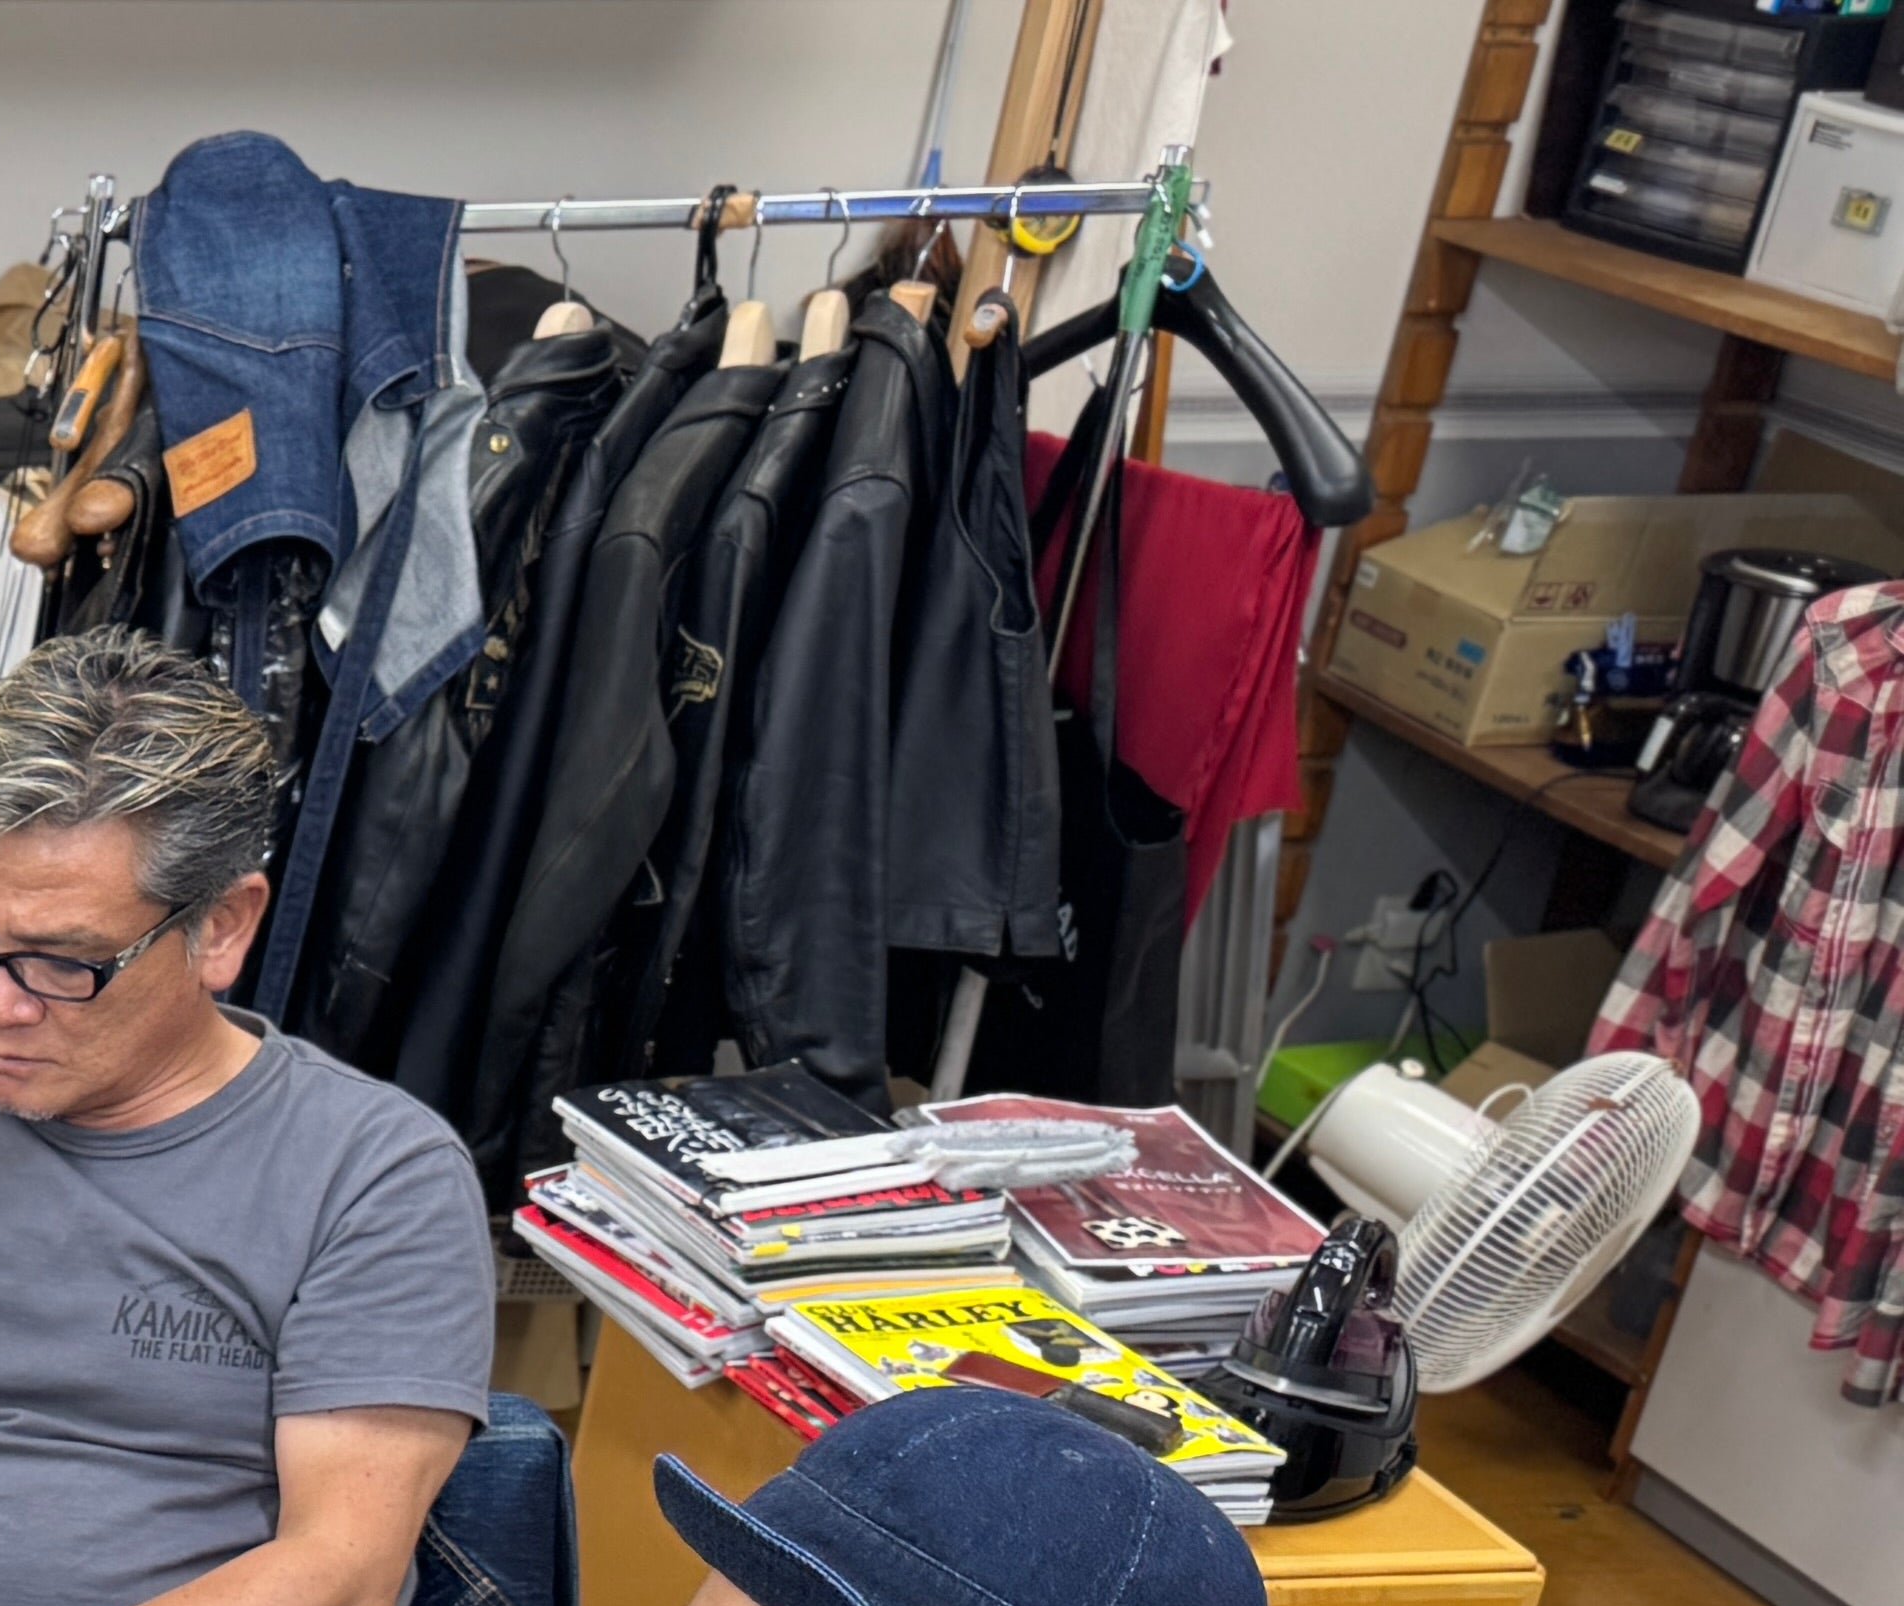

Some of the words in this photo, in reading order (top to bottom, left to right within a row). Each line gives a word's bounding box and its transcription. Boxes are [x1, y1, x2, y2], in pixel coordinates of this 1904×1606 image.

[111, 1294, 252, 1345] KAMIKA
[805, 1304, 878, 1317] CLUB
[819, 1300, 1034, 1335] HARLEY
[130, 1338, 165, 1361] THE
[168, 1342, 215, 1365] FLAT
[218, 1347, 266, 1370] HEAD
